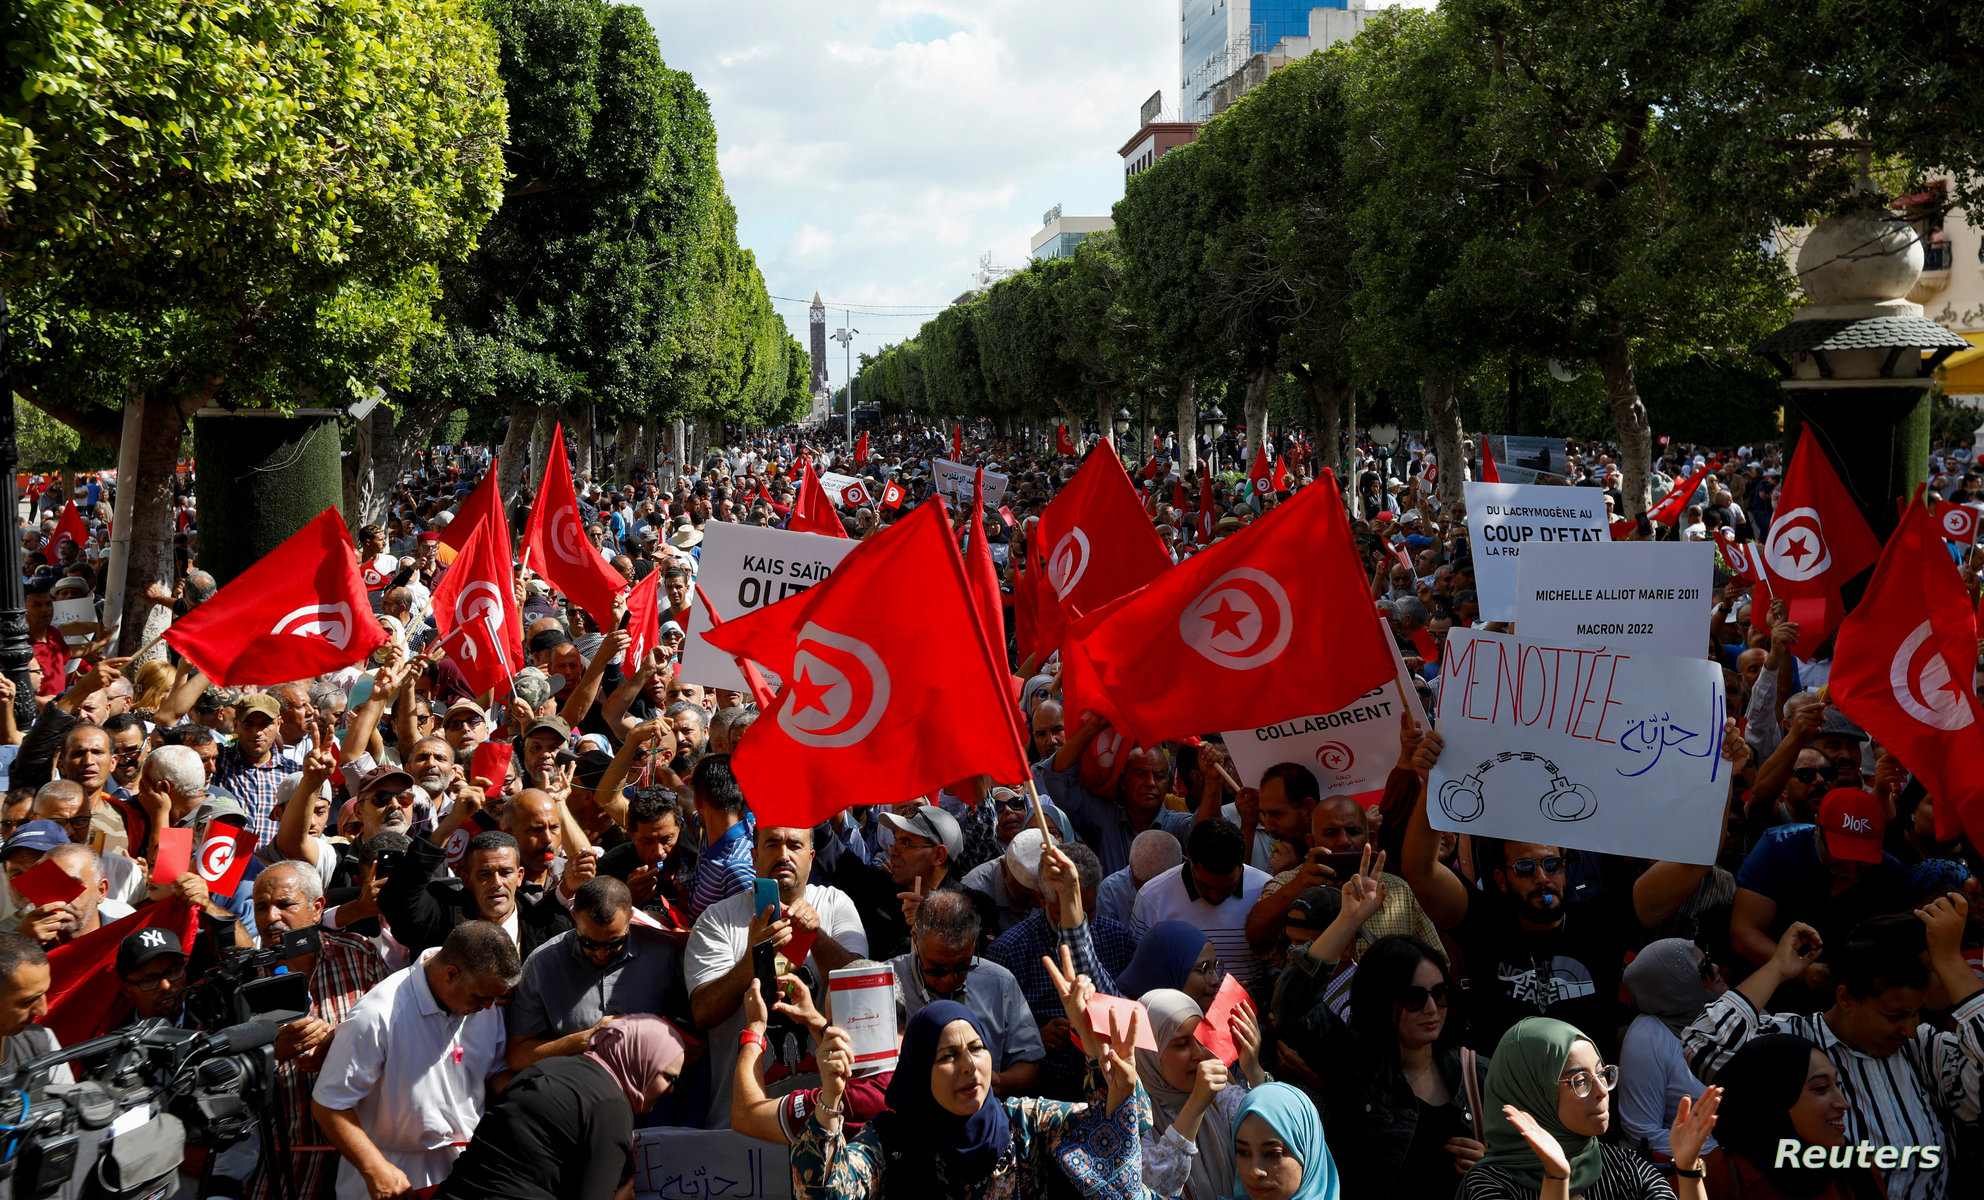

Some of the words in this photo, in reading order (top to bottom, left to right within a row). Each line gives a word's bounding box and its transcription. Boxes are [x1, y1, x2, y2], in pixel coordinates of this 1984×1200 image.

[1486, 505, 1500, 515] DU
[1502, 506, 1577, 518] LACRYMOGÈNE
[1579, 510, 1593, 519] AU
[1484, 524, 1533, 542] COUP
[1540, 527, 1603, 542] D'ETAT
[1485, 546, 1500, 556] LA
[743, 555, 785, 575] KAIS
[1535, 589, 1593, 601] MICHELLE
[1595, 589, 1636, 600] ALLIOT
[1638, 588, 1675, 600] MARIE
[1677, 588, 1699, 600] 2011
[1576, 624, 1624, 635] MACRON
[1627, 623, 1654, 635] 2022
[1437, 638, 1631, 744] MENOTTÉE
[1255, 701, 1392, 741] COLLABORENT
[1841, 812, 1872, 834] DIOR
